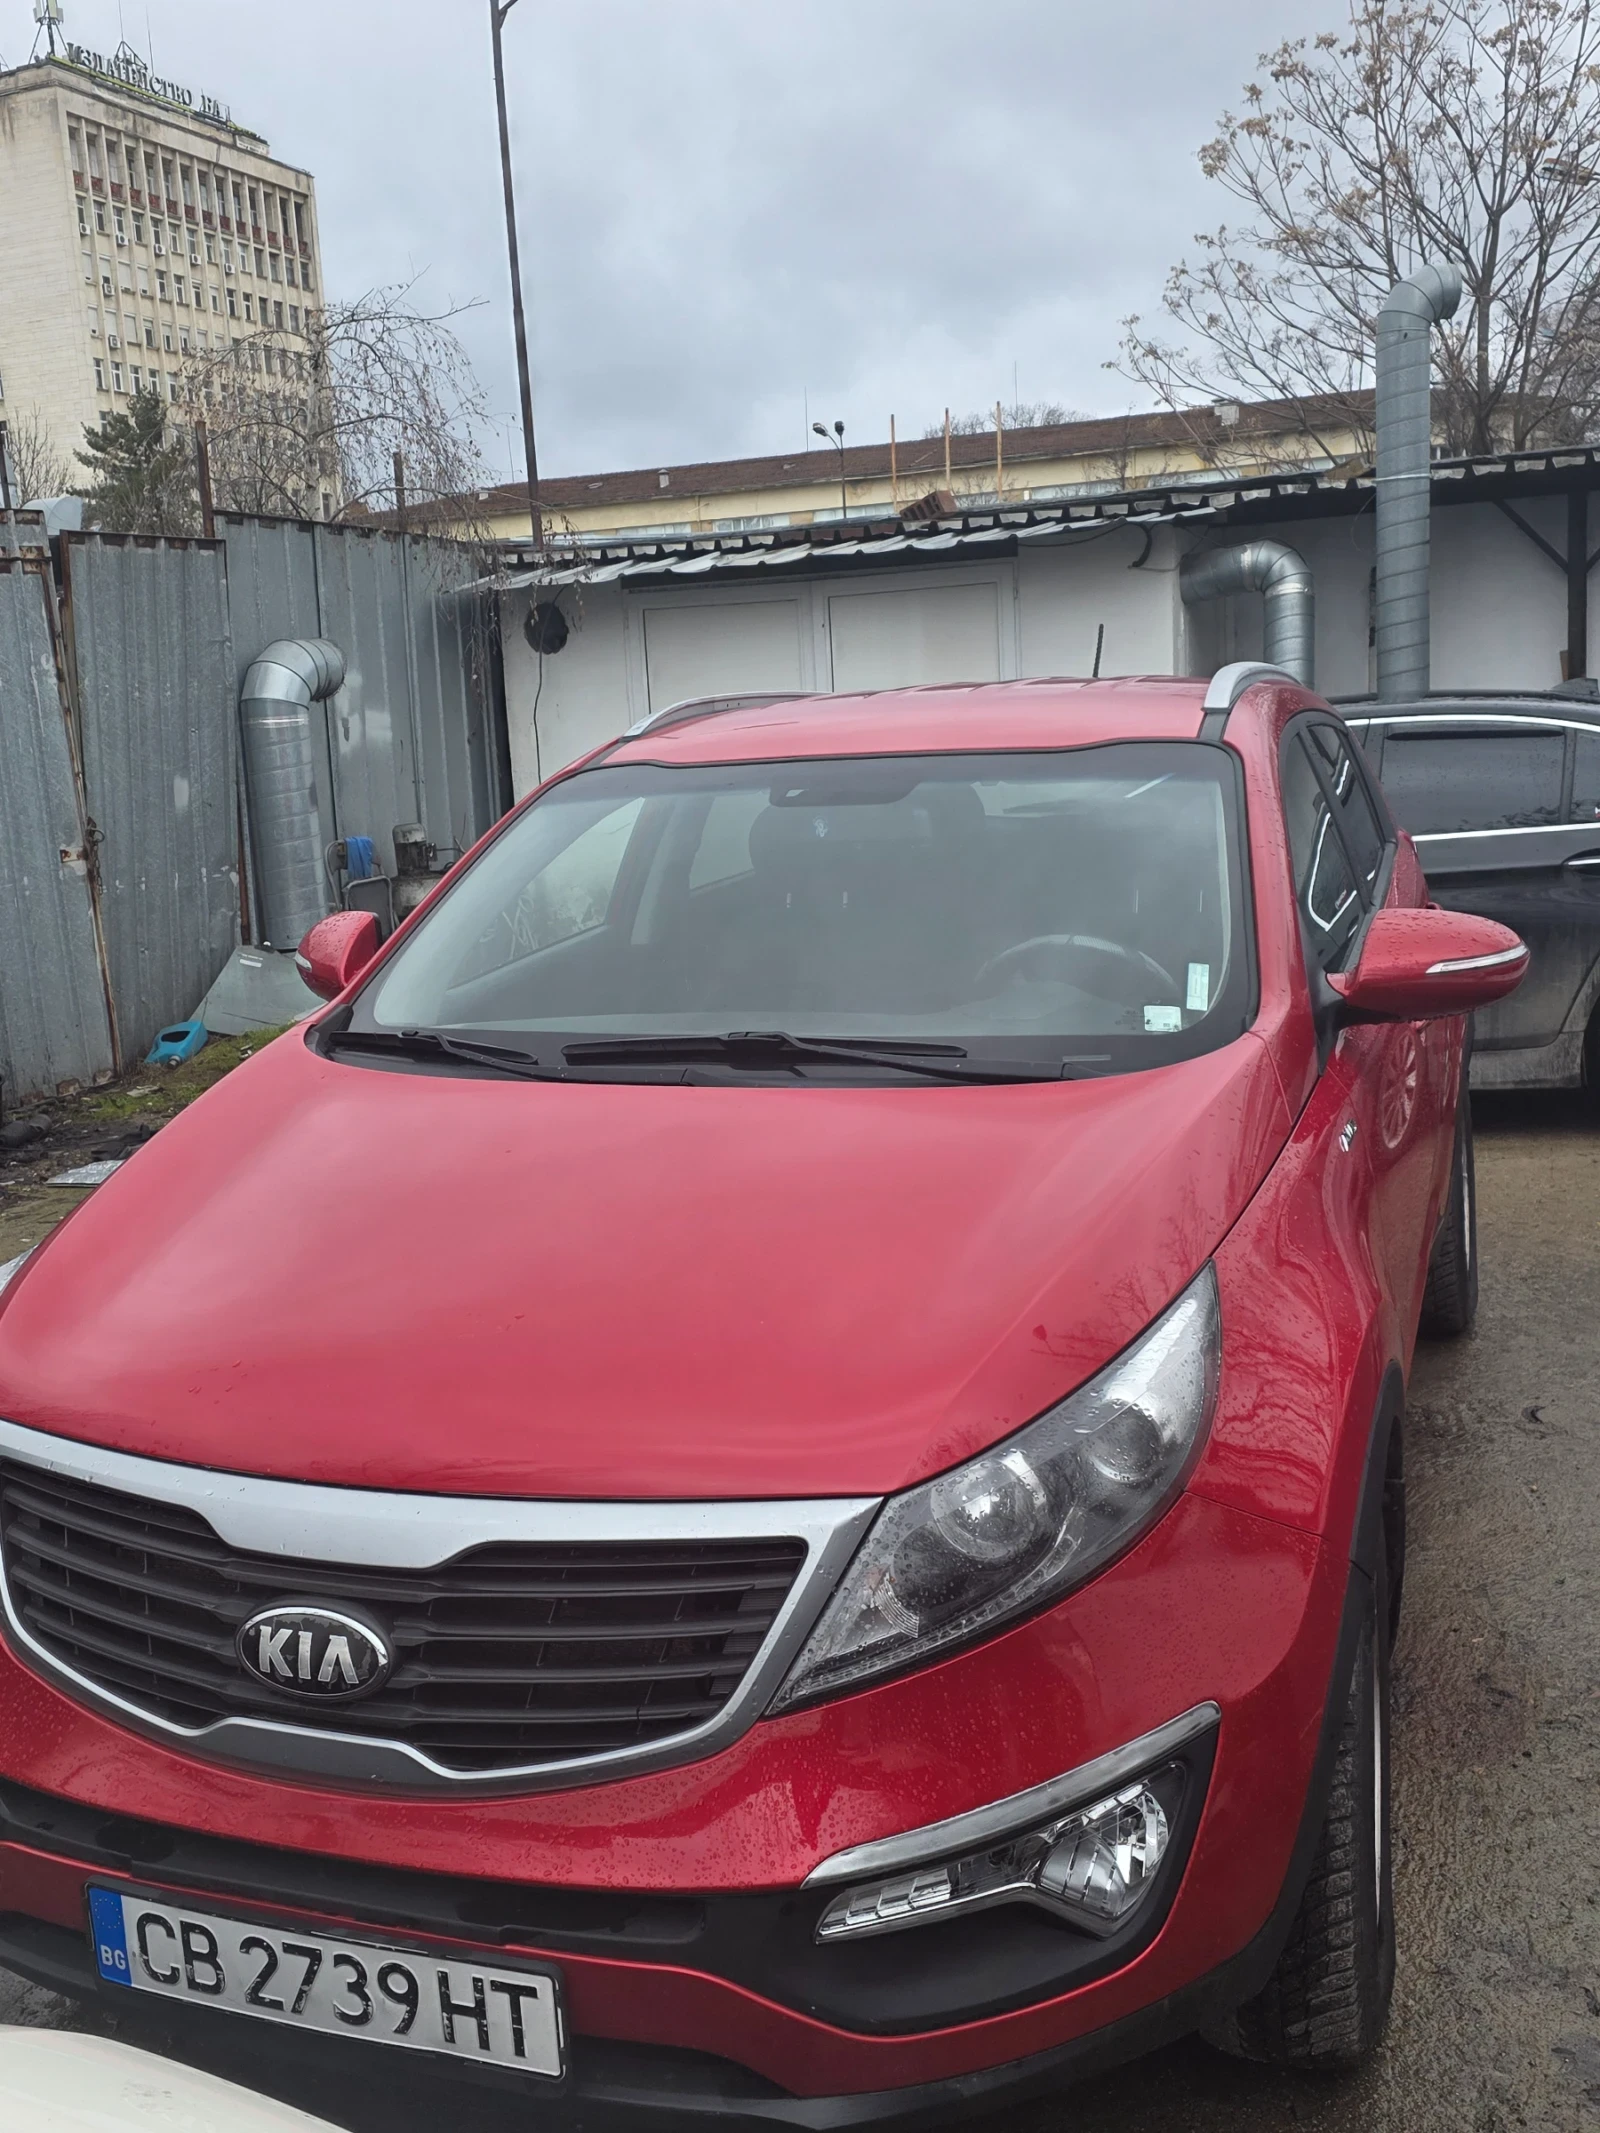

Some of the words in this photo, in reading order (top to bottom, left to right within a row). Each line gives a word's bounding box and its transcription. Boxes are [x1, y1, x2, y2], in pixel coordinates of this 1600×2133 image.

[259, 1624, 360, 1684] KIA
[100, 1944, 127, 1971] BG
[238, 1936, 420, 2035] 2739
